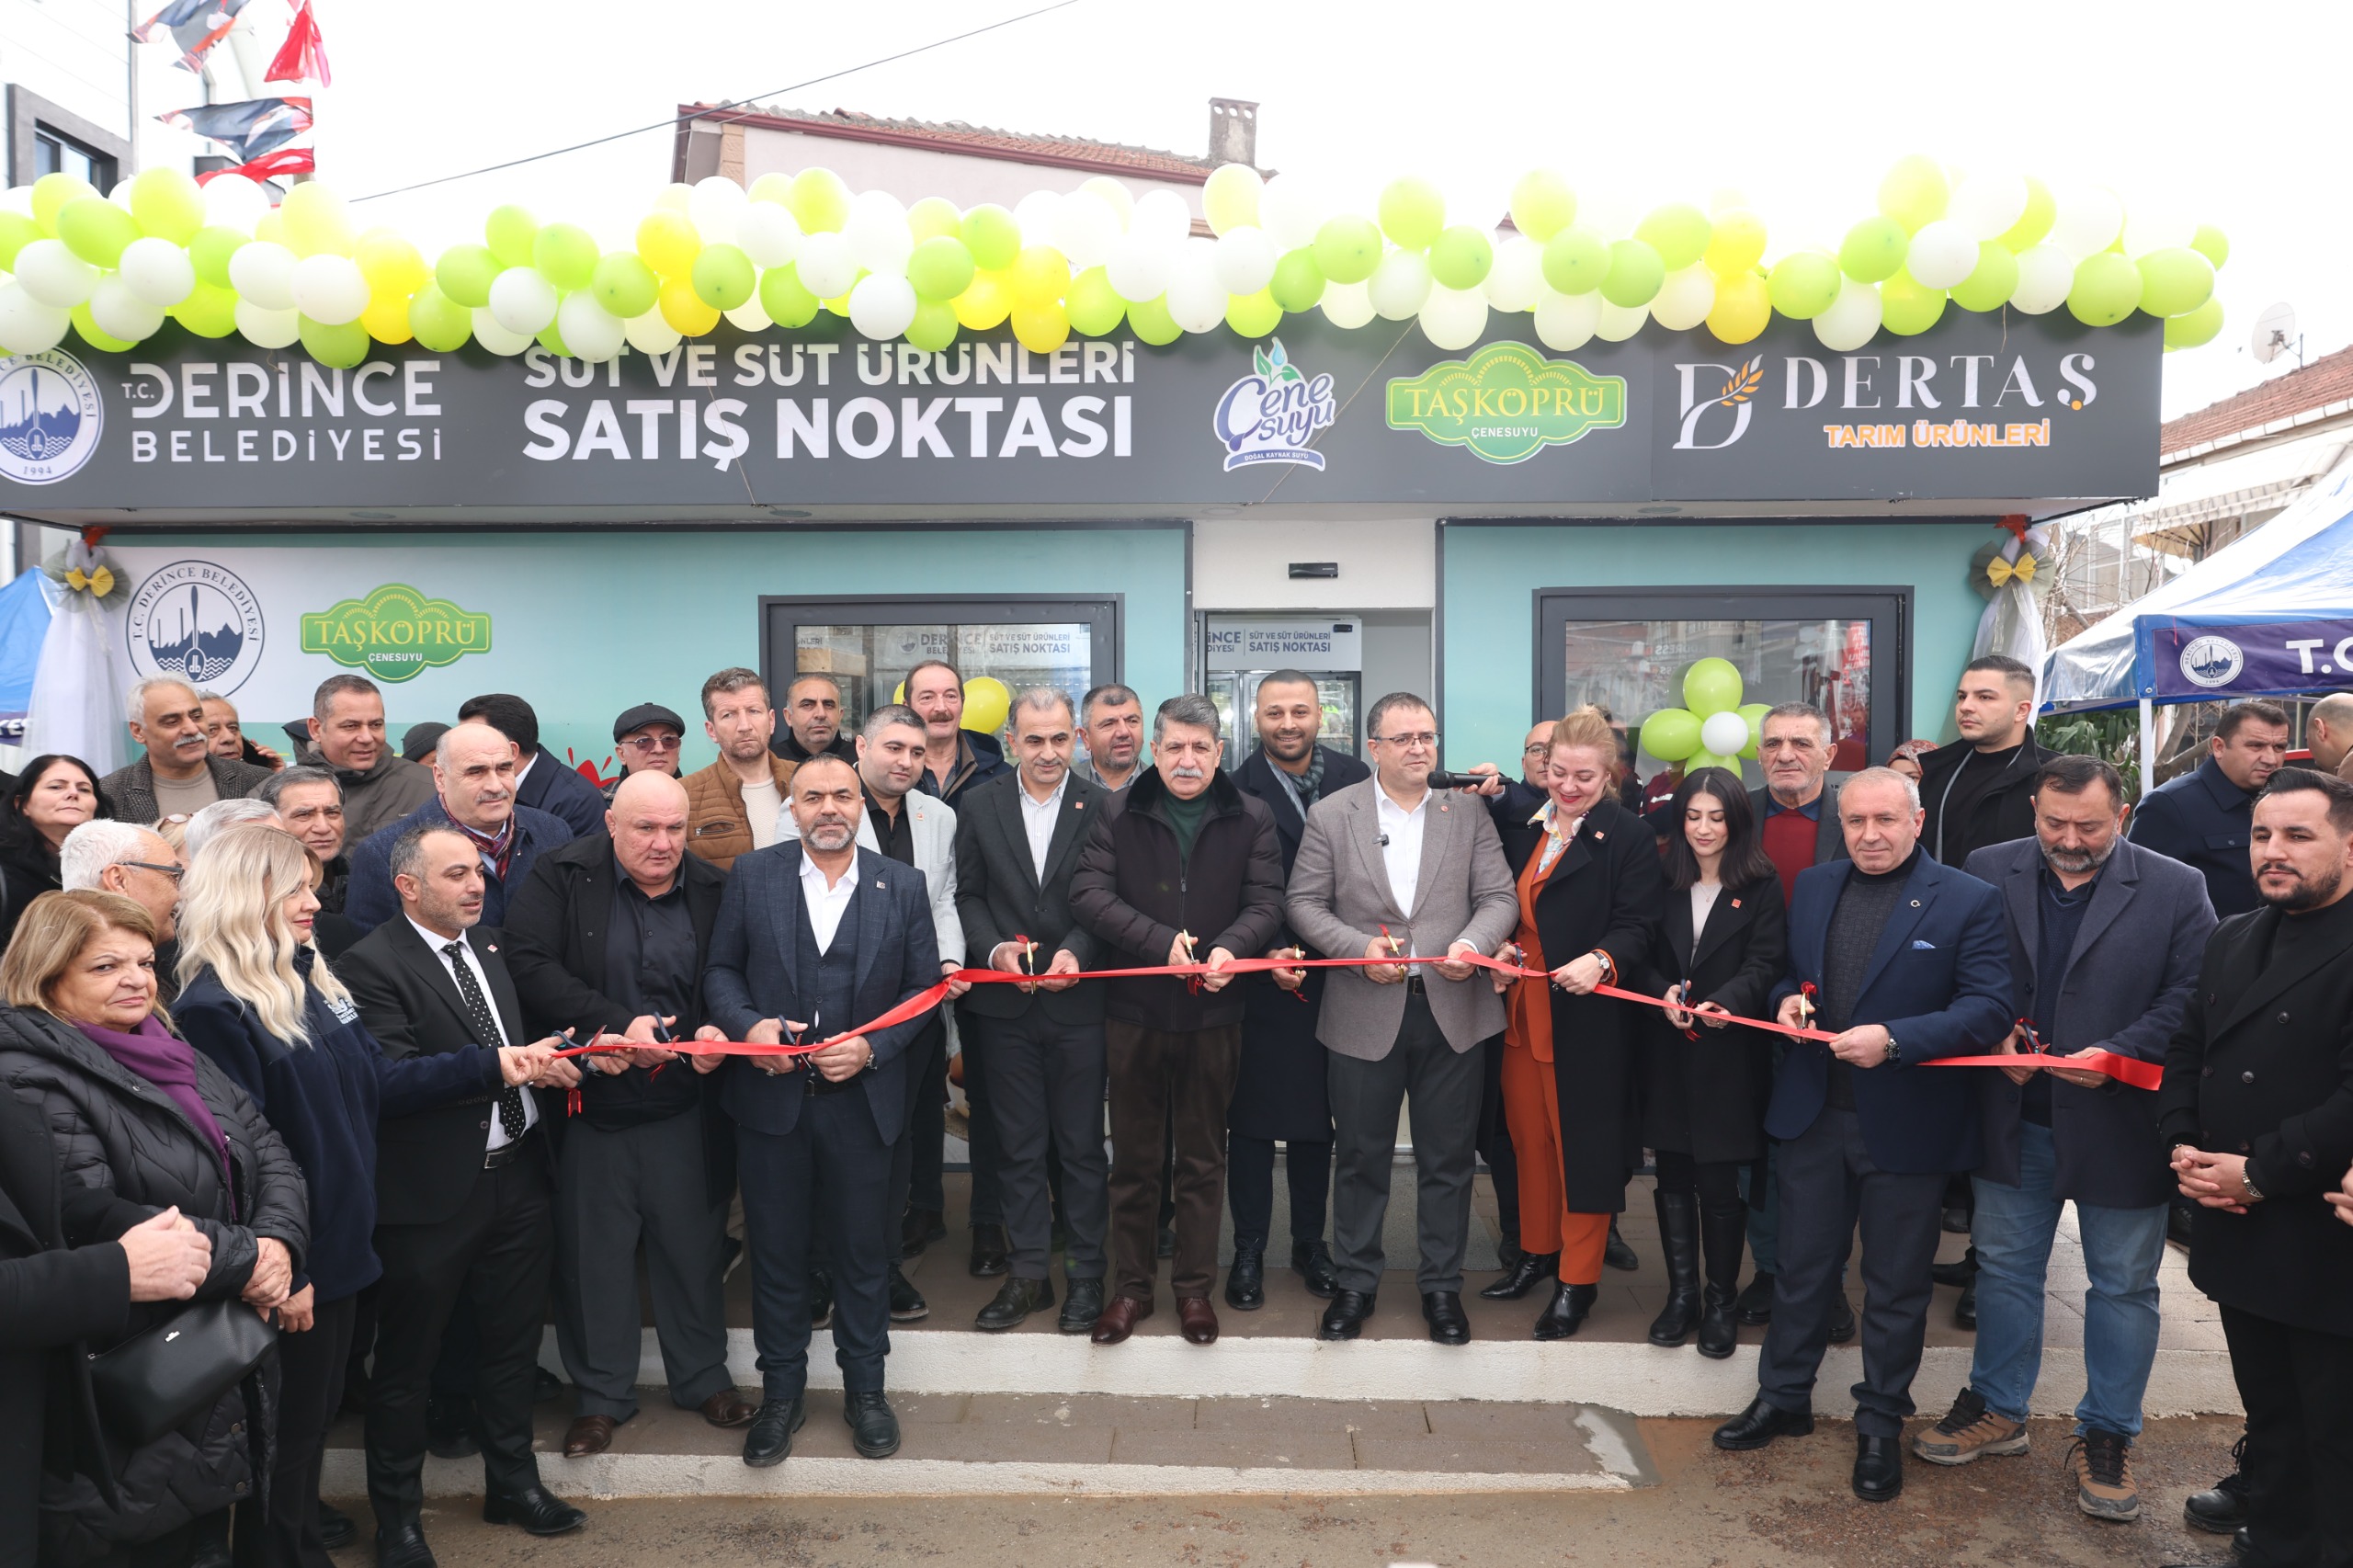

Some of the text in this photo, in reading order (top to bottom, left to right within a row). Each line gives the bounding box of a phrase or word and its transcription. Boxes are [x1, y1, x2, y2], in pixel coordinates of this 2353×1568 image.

[649, 344, 717, 387] VE
[733, 342, 839, 387] SÜT
[857, 340, 1135, 386] ÜRÜNLERİ
[121, 382, 155, 399] T.C.
[130, 360, 442, 419] DERİNCE
[1782, 353, 2098, 411] DERTAŞ
[1404, 386, 1606, 426] TAŞKÖPRÜ
[522, 395, 1132, 472] SATIŞ NOKTASI
[1257, 400, 1333, 447] suyu
[1472, 426, 1539, 439] ÇENESUYU
[1824, 418, 2052, 449] TARIM ÜRÜNLERİ
[131, 428, 441, 462] BELEDİYESİ
[1245, 452, 1266, 461] DOĞAL
[1291, 451, 1309, 460] SUYU
[23, 466, 52, 475] 1994
[140, 567, 196, 608] DERİNCE
[200, 568, 260, 642] BELEDİYESİ
[314, 620, 477, 652] TAŞKÖPRÜ
[989, 632, 1071, 642] SÜT VE SÜT ÜRÜNLERİ
[989, 642, 1071, 654] SATIŞ NOKTASI
[1249, 631, 1263, 640] SÜT
[1277, 631, 1291, 640] SÜT
[1293, 631, 1331, 640] ÜRÜNLERİ
[1249, 642, 1331, 653] SATIŞ NOKTASI
[368, 653, 423, 663] ÇENESUYU
